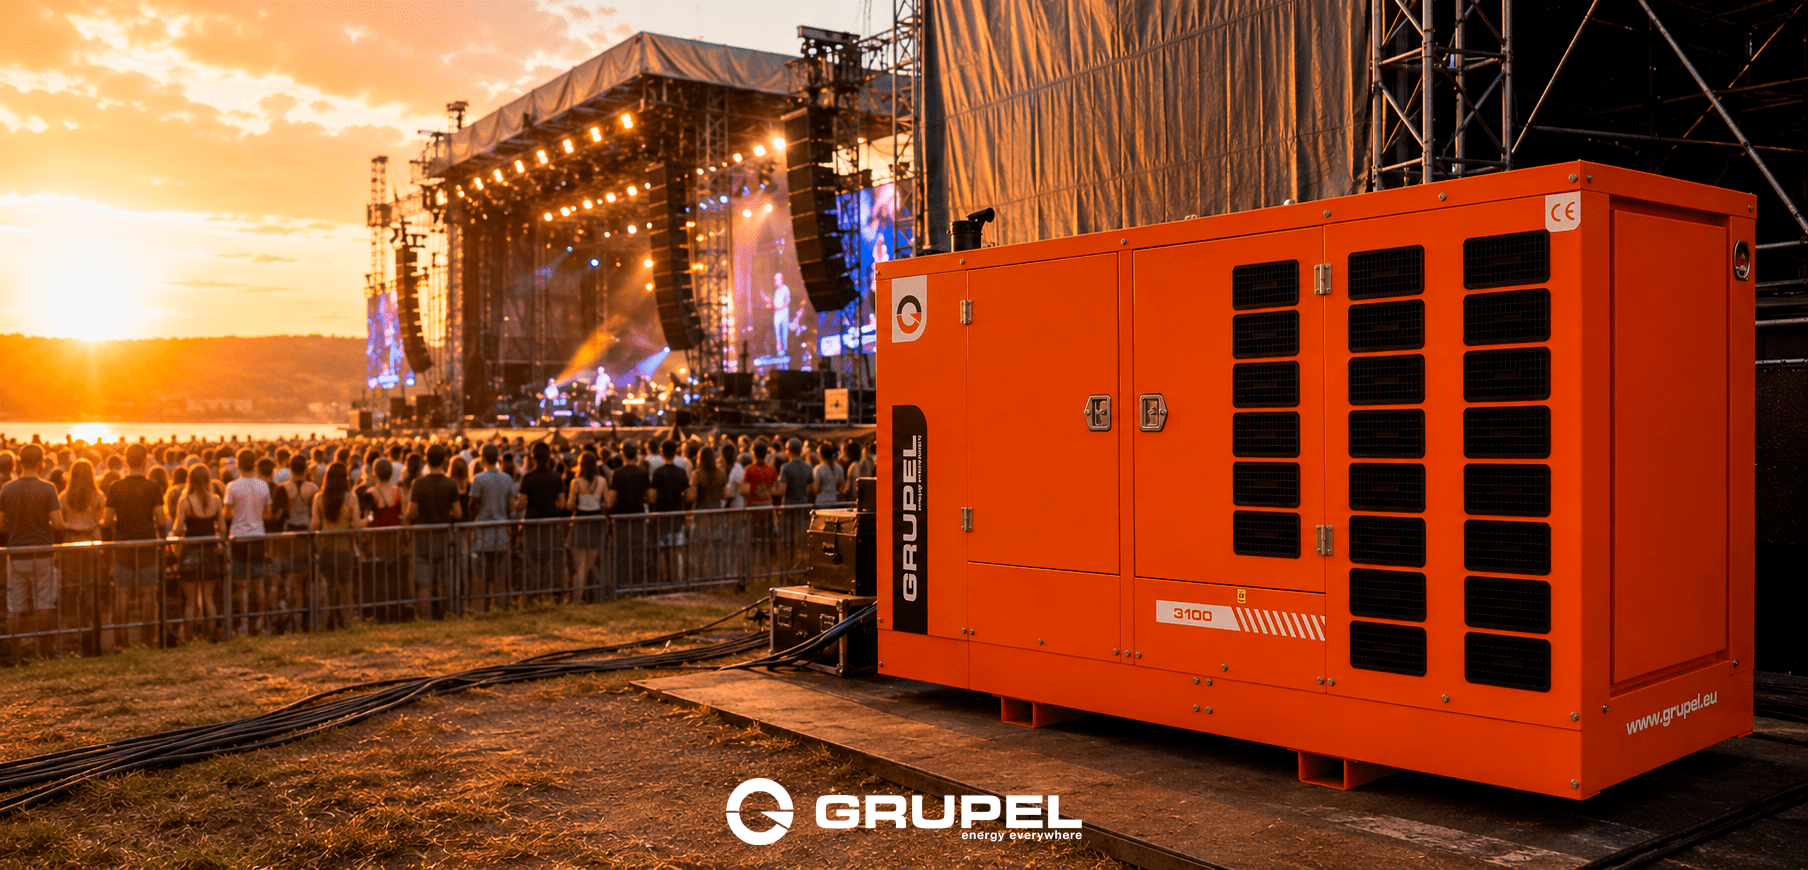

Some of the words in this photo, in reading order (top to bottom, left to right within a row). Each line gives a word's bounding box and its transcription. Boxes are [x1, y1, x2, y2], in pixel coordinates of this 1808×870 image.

[1551, 201, 1576, 222] CE
[902, 435, 917, 602] GRUPEL
[1173, 607, 1213, 622] 3100
[1626, 691, 1718, 736] www.grupel.eu
